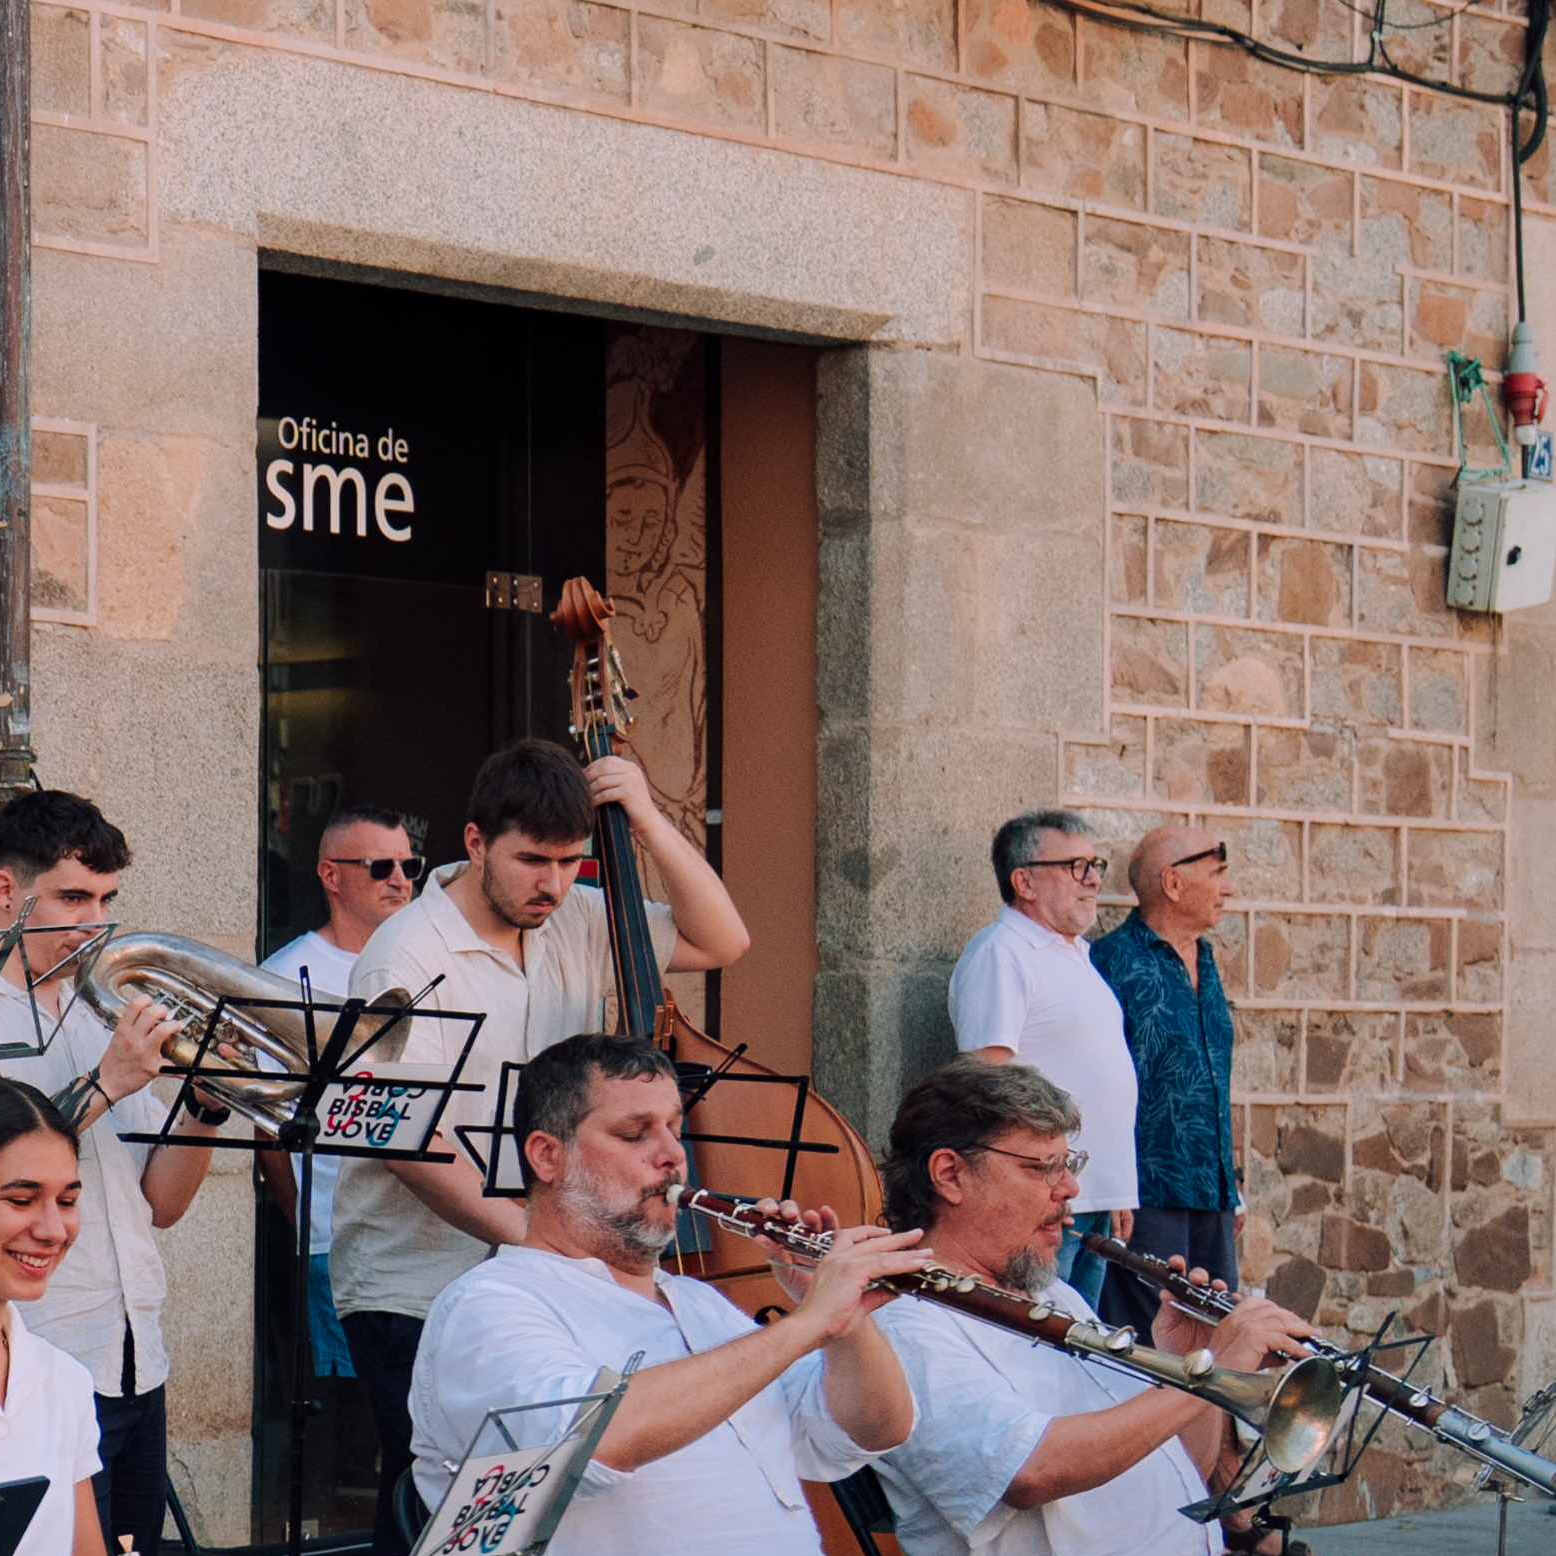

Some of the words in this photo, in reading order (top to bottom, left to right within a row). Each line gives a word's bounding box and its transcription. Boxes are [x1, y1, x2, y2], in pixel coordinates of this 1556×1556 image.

[278, 416, 369, 458] Oficina
[378, 428, 409, 463] de
[327, 1099, 412, 1120] BISBAL
[323, 1121, 393, 1143] JOVE
